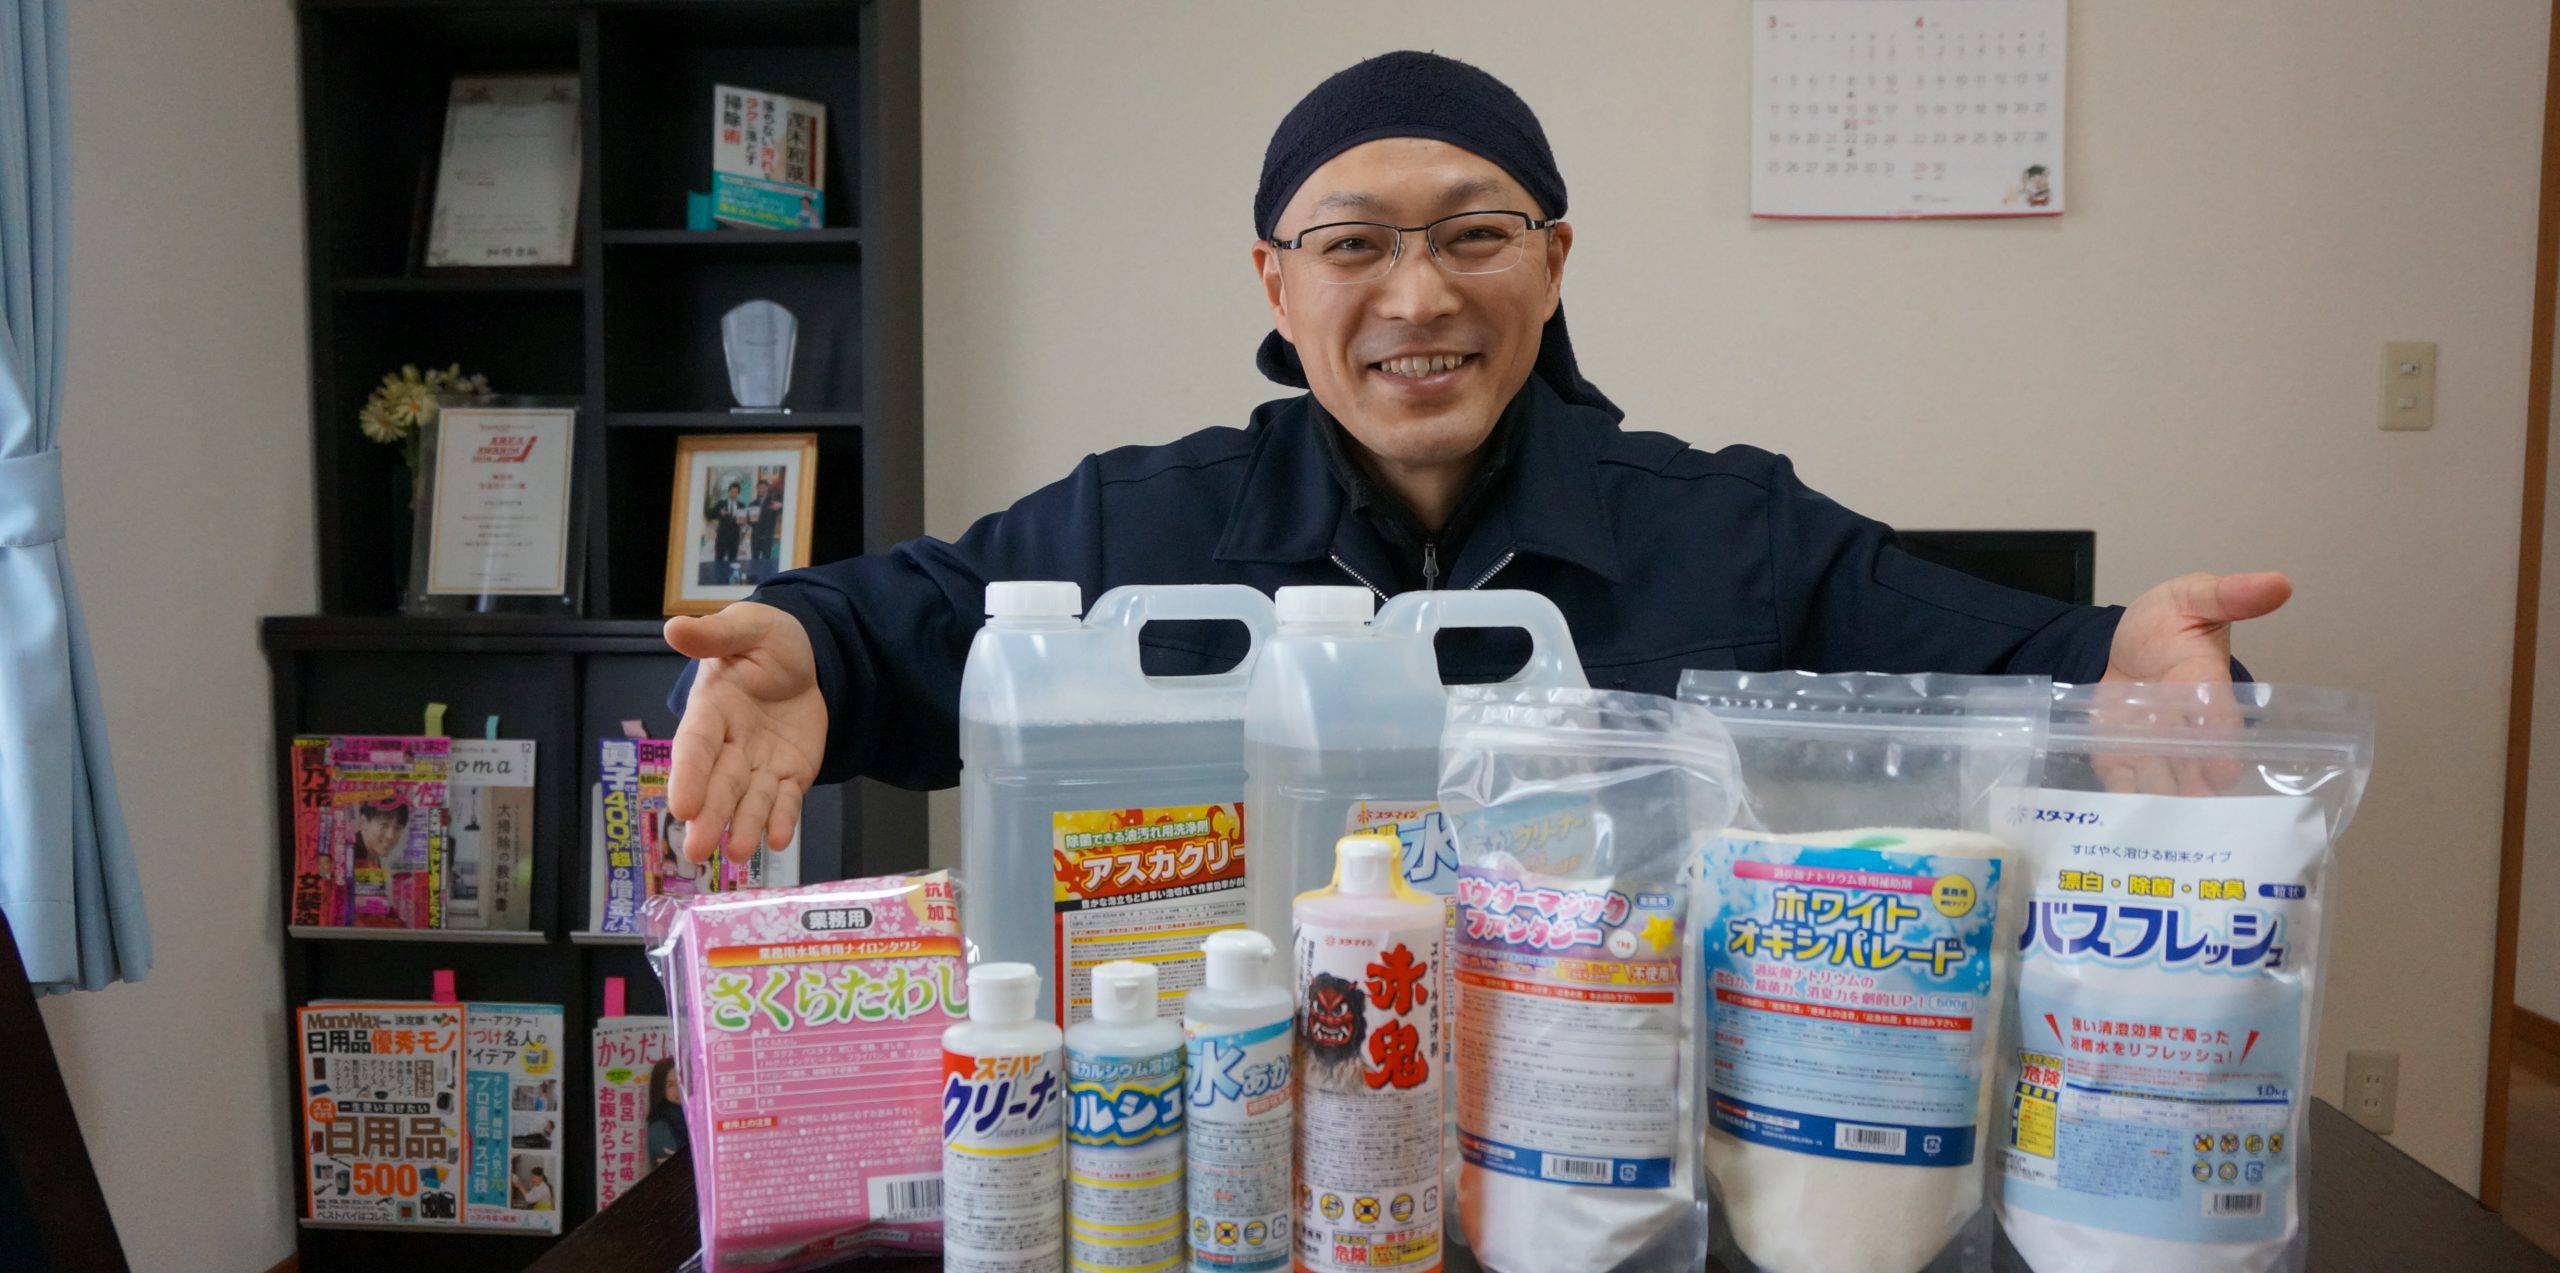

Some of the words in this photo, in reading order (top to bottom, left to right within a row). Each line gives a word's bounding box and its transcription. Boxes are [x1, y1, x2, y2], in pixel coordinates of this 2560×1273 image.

[1768, 17, 1777, 28] 3
[1915, 17, 1924, 28] 4
[521, 743, 532, 753] 12
[641, 744, 672, 763] 田中
[1065, 819, 1210, 849] 除菌できる油汚れ用洗浄剤
[2071, 843, 2233, 864] すばやく溶ける粉末タイプ
[1773, 867, 1913, 891] 過炭酸ナトリウム専用補助剤
[2058, 869, 2247, 901] 漂白・除菌・除臭
[808, 910, 866, 929] 業務用
[1774, 886, 1919, 932] ホワイト
[1466, 910, 1603, 950] ファンタジー
[2018, 901, 2284, 968] バスフレッシュ
[1729, 919, 1966, 976] オキシパレード
[1633, 965, 1670, 981] 不使用
[1754, 963, 1875, 989] 過炭酸ナトリウムの
[709, 962, 969, 1031] さくらたわし
[307, 1012, 381, 1030] MonoMax
[1363, 942, 1430, 1090] 赤鬼
[307, 1029, 456, 1055] 日用品優秀モノ
[468, 1028, 547, 1047] づけ名人の
[2071, 1016, 2230, 1045] 強い清澄効果で濁った
[467, 1048, 516, 1065] イデア
[2070, 1036, 2234, 1064] 浴槽水をリフレッシュ!
[2023, 1064, 2062, 1090] 危険
[325, 1116, 447, 1160] 日用品
[352, 1162, 418, 1197] 500
[1334, 1245, 1368, 1265] 危険
